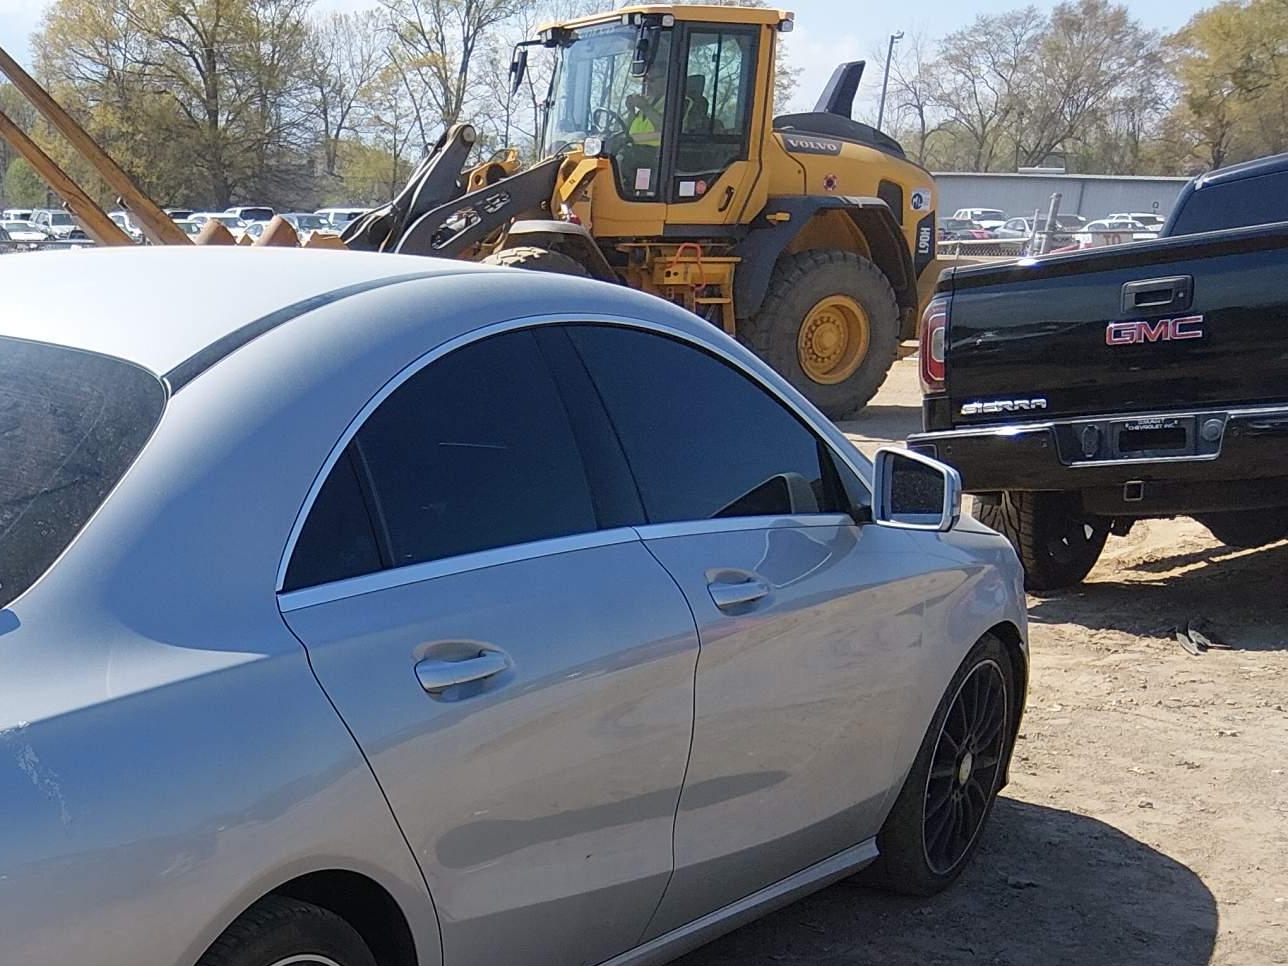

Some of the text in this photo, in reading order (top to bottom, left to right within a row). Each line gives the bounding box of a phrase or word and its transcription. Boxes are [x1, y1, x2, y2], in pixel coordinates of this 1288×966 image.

[787, 139, 838, 151] VOLVO
[918, 227, 931, 254] L90H
[1106, 315, 1204, 345] GMC
[960, 398, 1047, 416] SIERRA
